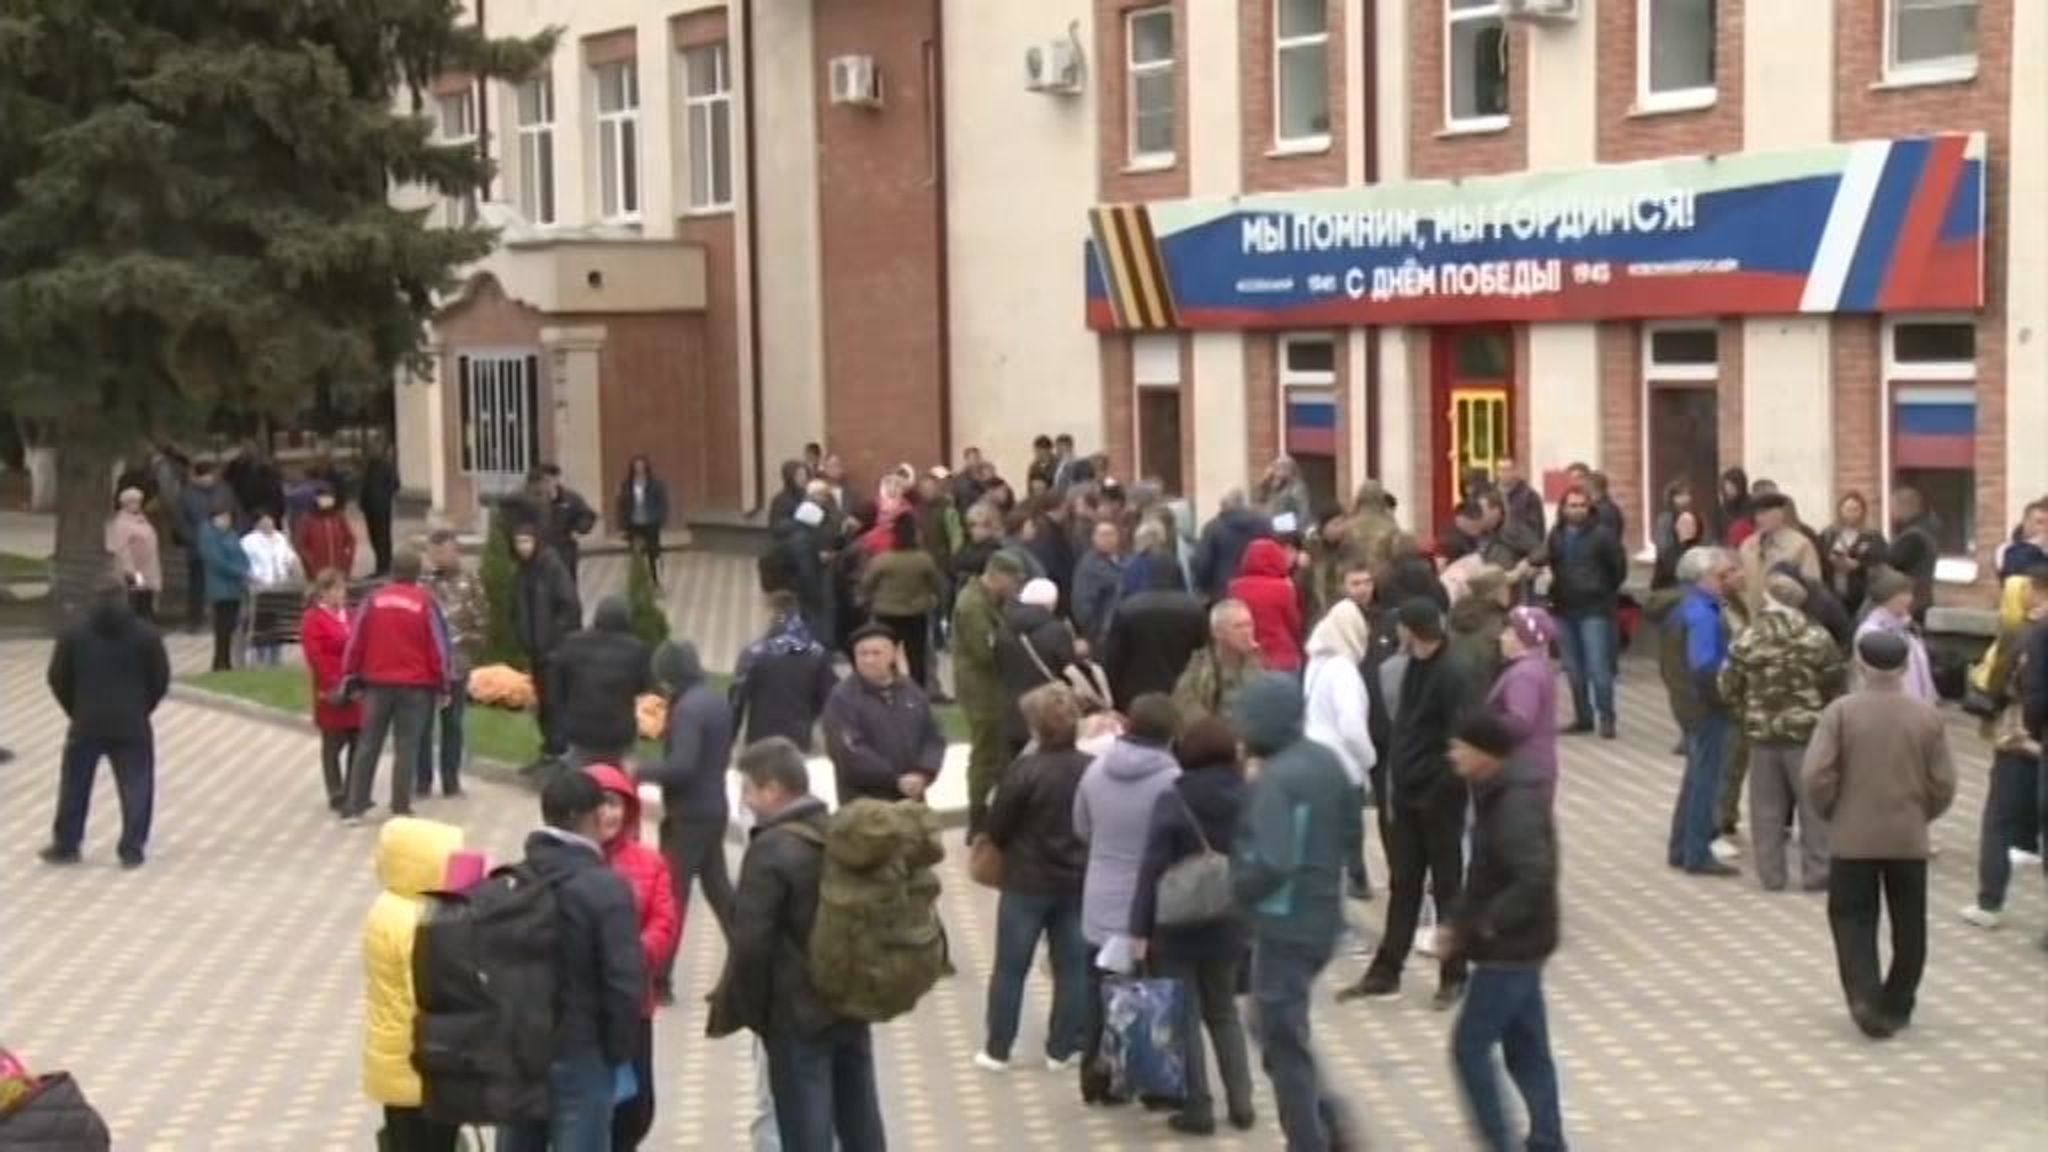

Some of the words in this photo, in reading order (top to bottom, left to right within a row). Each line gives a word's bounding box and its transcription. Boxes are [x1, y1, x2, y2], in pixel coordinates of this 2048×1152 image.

[1242, 214, 1286, 254] МЫ
[1292, 209, 1425, 251] ПОМНИМ,
[1434, 205, 1484, 244] МЫ
[1492, 188, 1695, 243] ГОРДИМСЯ!
[1345, 266, 1365, 299] С
[1371, 257, 1437, 302] ДНЁМ
